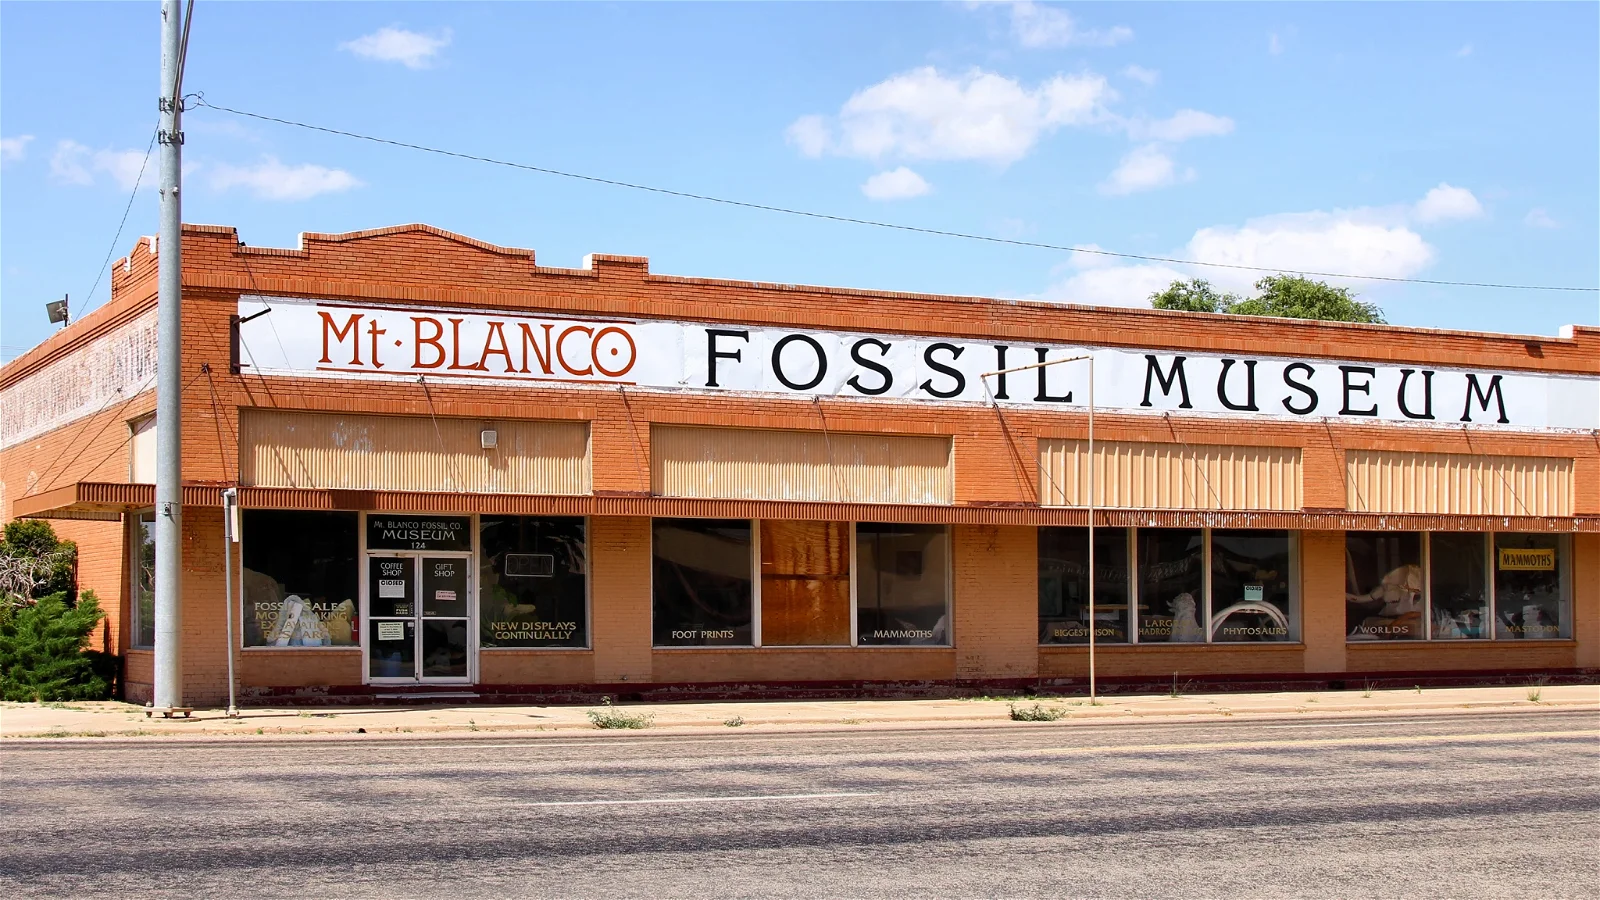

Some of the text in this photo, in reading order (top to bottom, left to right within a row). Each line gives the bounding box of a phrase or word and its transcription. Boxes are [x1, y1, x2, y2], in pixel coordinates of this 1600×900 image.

[410, 316, 637, 377] BLANCO
[704, 328, 1073, 403] FOSSIL
[1139, 354, 1510, 424] MUSEUM
[388, 521, 419, 529] BLANCO
[421, 521, 448, 530] FOSSIL
[449, 522, 463, 530] CO.
[382, 529, 456, 541] MUSEUM
[411, 541, 426, 550] 124
[1502, 553, 1552, 567] MAMMOTHS
[380, 562, 404, 570] COFFEE
[382, 569, 402, 577] SHOP
[254, 602, 347, 611] FOSS SALES
[304, 611, 347, 621] AKING
[491, 622, 577, 630] NEW DISPLAYS
[1361, 626, 1409, 634] WORLDS
[1505, 625, 1560, 633] MASTODON
[495, 631, 572, 640] CONTINUALLY
[672, 630, 734, 639] FOOT PRINTS
[873, 630, 933, 638] MAMMOTHS
[1054, 628, 1115, 637] BIGGEST ISON
[1138, 627, 1202, 636] HADROS
[1223, 627, 1287, 635] PHYTOSAURS
